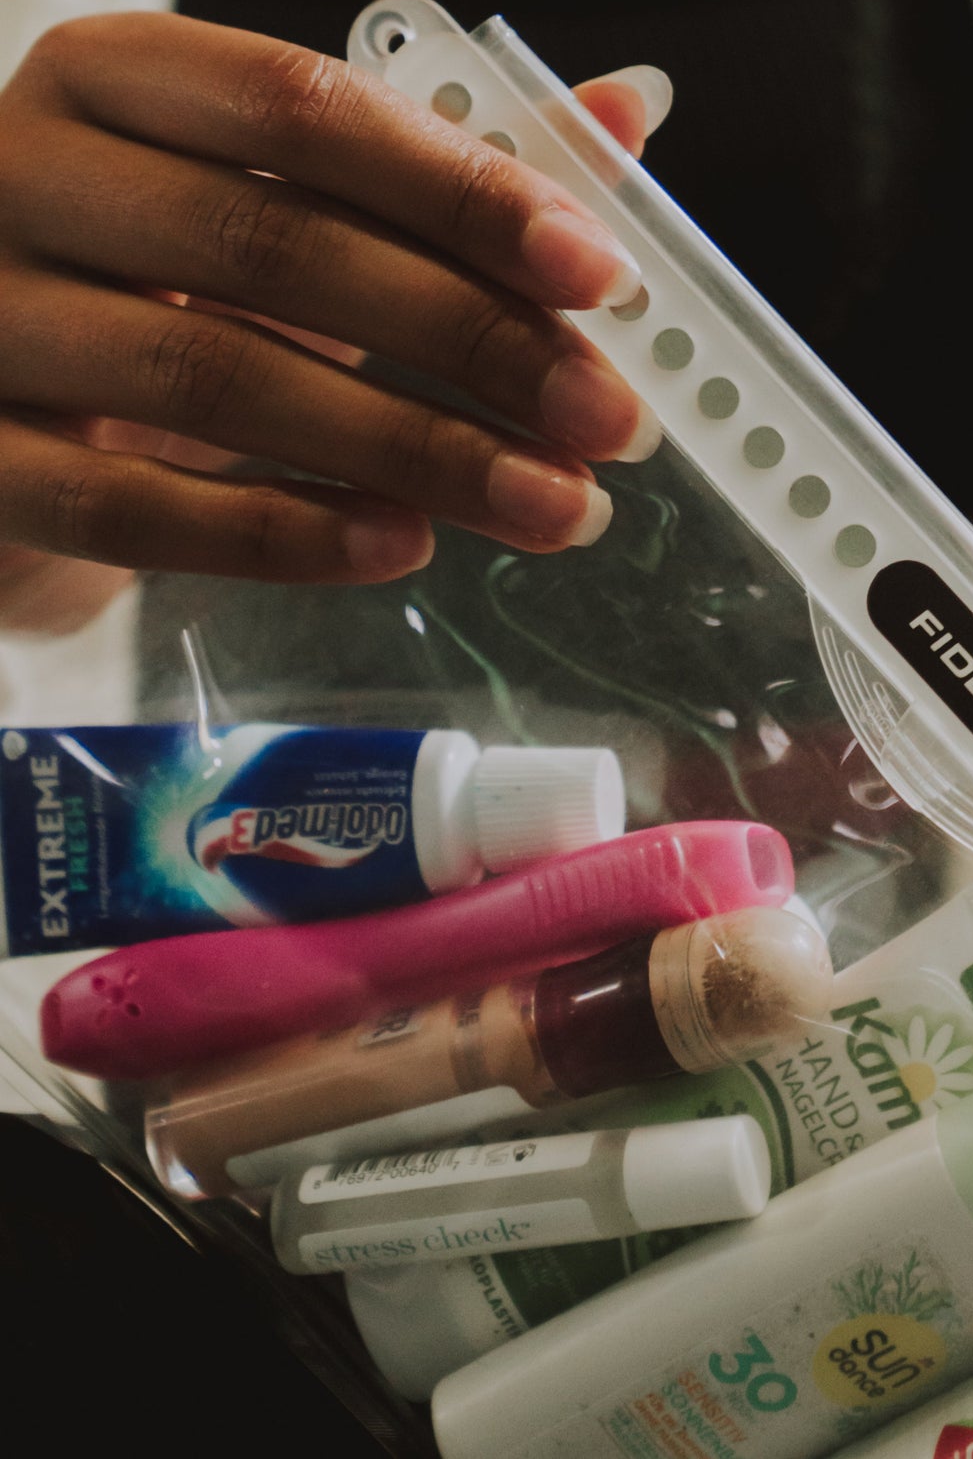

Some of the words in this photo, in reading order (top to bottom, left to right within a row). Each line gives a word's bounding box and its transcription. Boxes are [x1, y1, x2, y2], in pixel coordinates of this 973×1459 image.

[29, 755, 69, 938] EXTREME
[64, 796, 89, 892] FRESH
[314, 1232, 417, 1266] stress
[708, 1328, 798, 1412] 30
[828, 1348, 885, 1398] dance
[851, 1329, 921, 1389] sun
